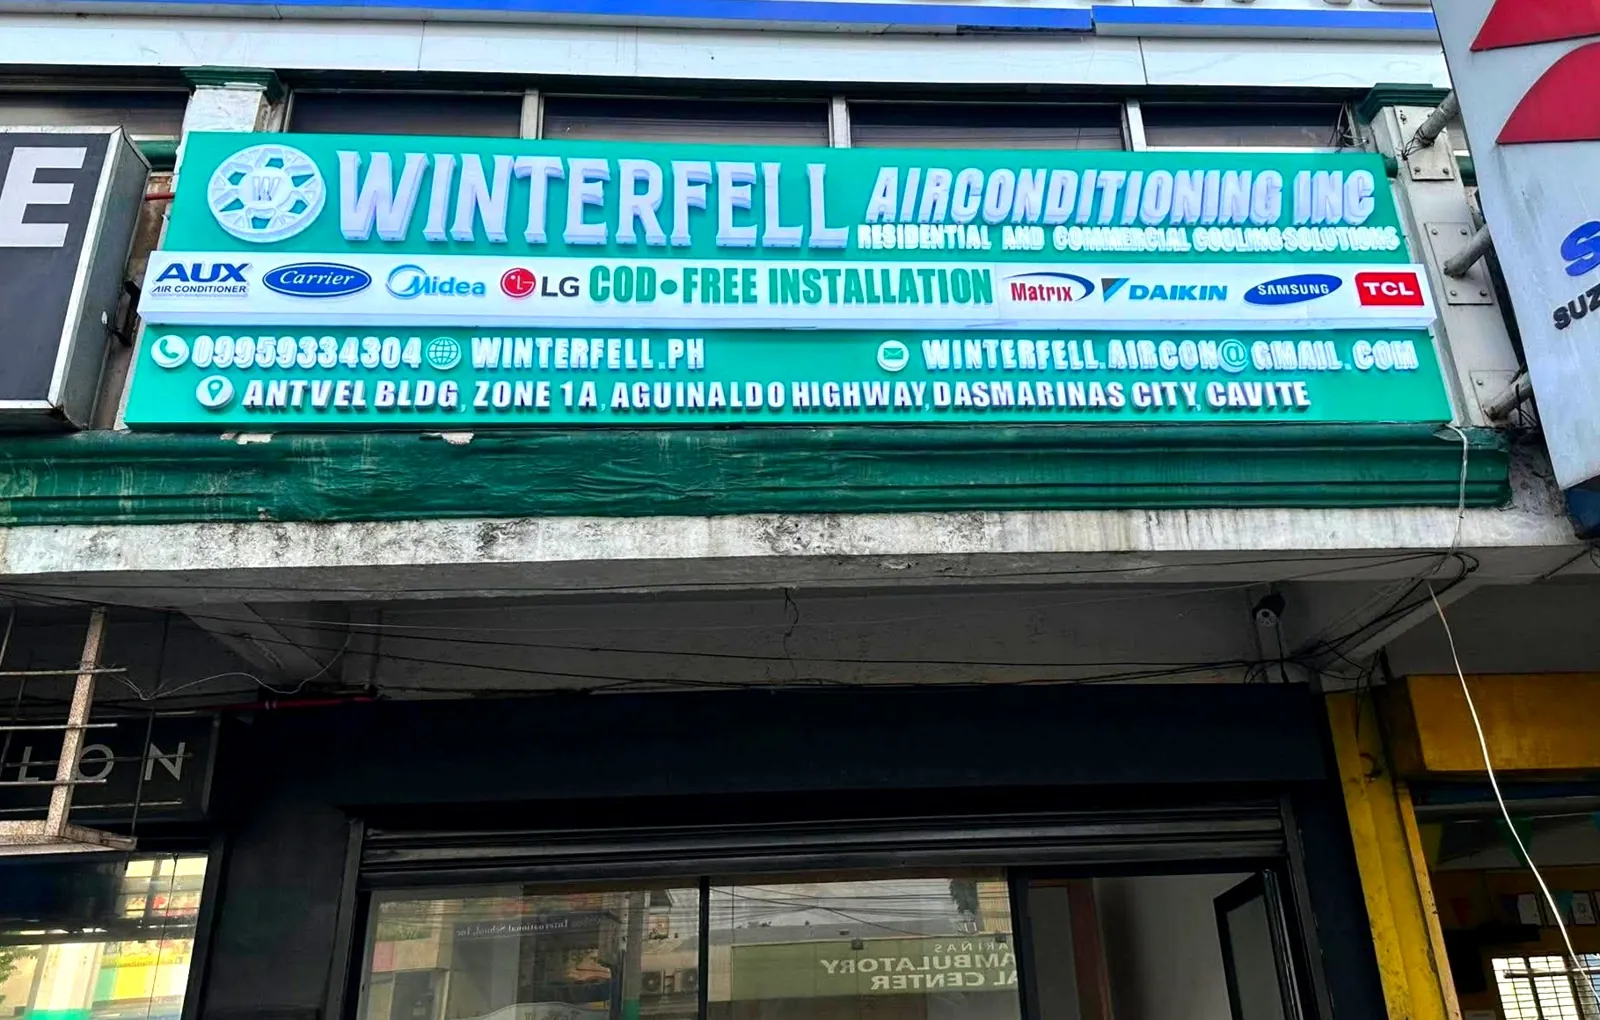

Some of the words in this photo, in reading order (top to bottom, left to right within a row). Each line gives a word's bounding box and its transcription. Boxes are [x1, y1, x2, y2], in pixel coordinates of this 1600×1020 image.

[0, 147, 88, 248] E
[337, 150, 849, 248] WINTERFELL
[865, 166, 1283, 225] AIRCONDITIONING
[1293, 169, 1375, 225] INC
[857, 223, 992, 250] RESIDENTIAL
[1001, 225, 1045, 251] AND
[1053, 226, 1191, 252] COMMERCIAL
[155, 262, 250, 283] AUX
[280, 269, 355, 286] Carrier
[152, 285, 172, 293] AIR
[174, 284, 247, 294] CONDITIONER
[398, 273, 487, 298] Midea
[540, 276, 580, 298] LG
[768, 267, 993, 305] INSTALLATION
[1010, 282, 1074, 302] Matrix
[1128, 284, 1228, 301] DAIKIN
[1257, 283, 1330, 296] SAMSUNG
[1362, 281, 1415, 296] TCL
[191, 335, 422, 369] 09959334304
[242, 379, 368, 409] ANTVEL
[472, 380, 551, 409] ZONE
[609, 381, 786, 410] AGUINALDO
[932, 380, 1126, 411] DASMARINAS
[1205, 381, 1312, 410] CAVITE
